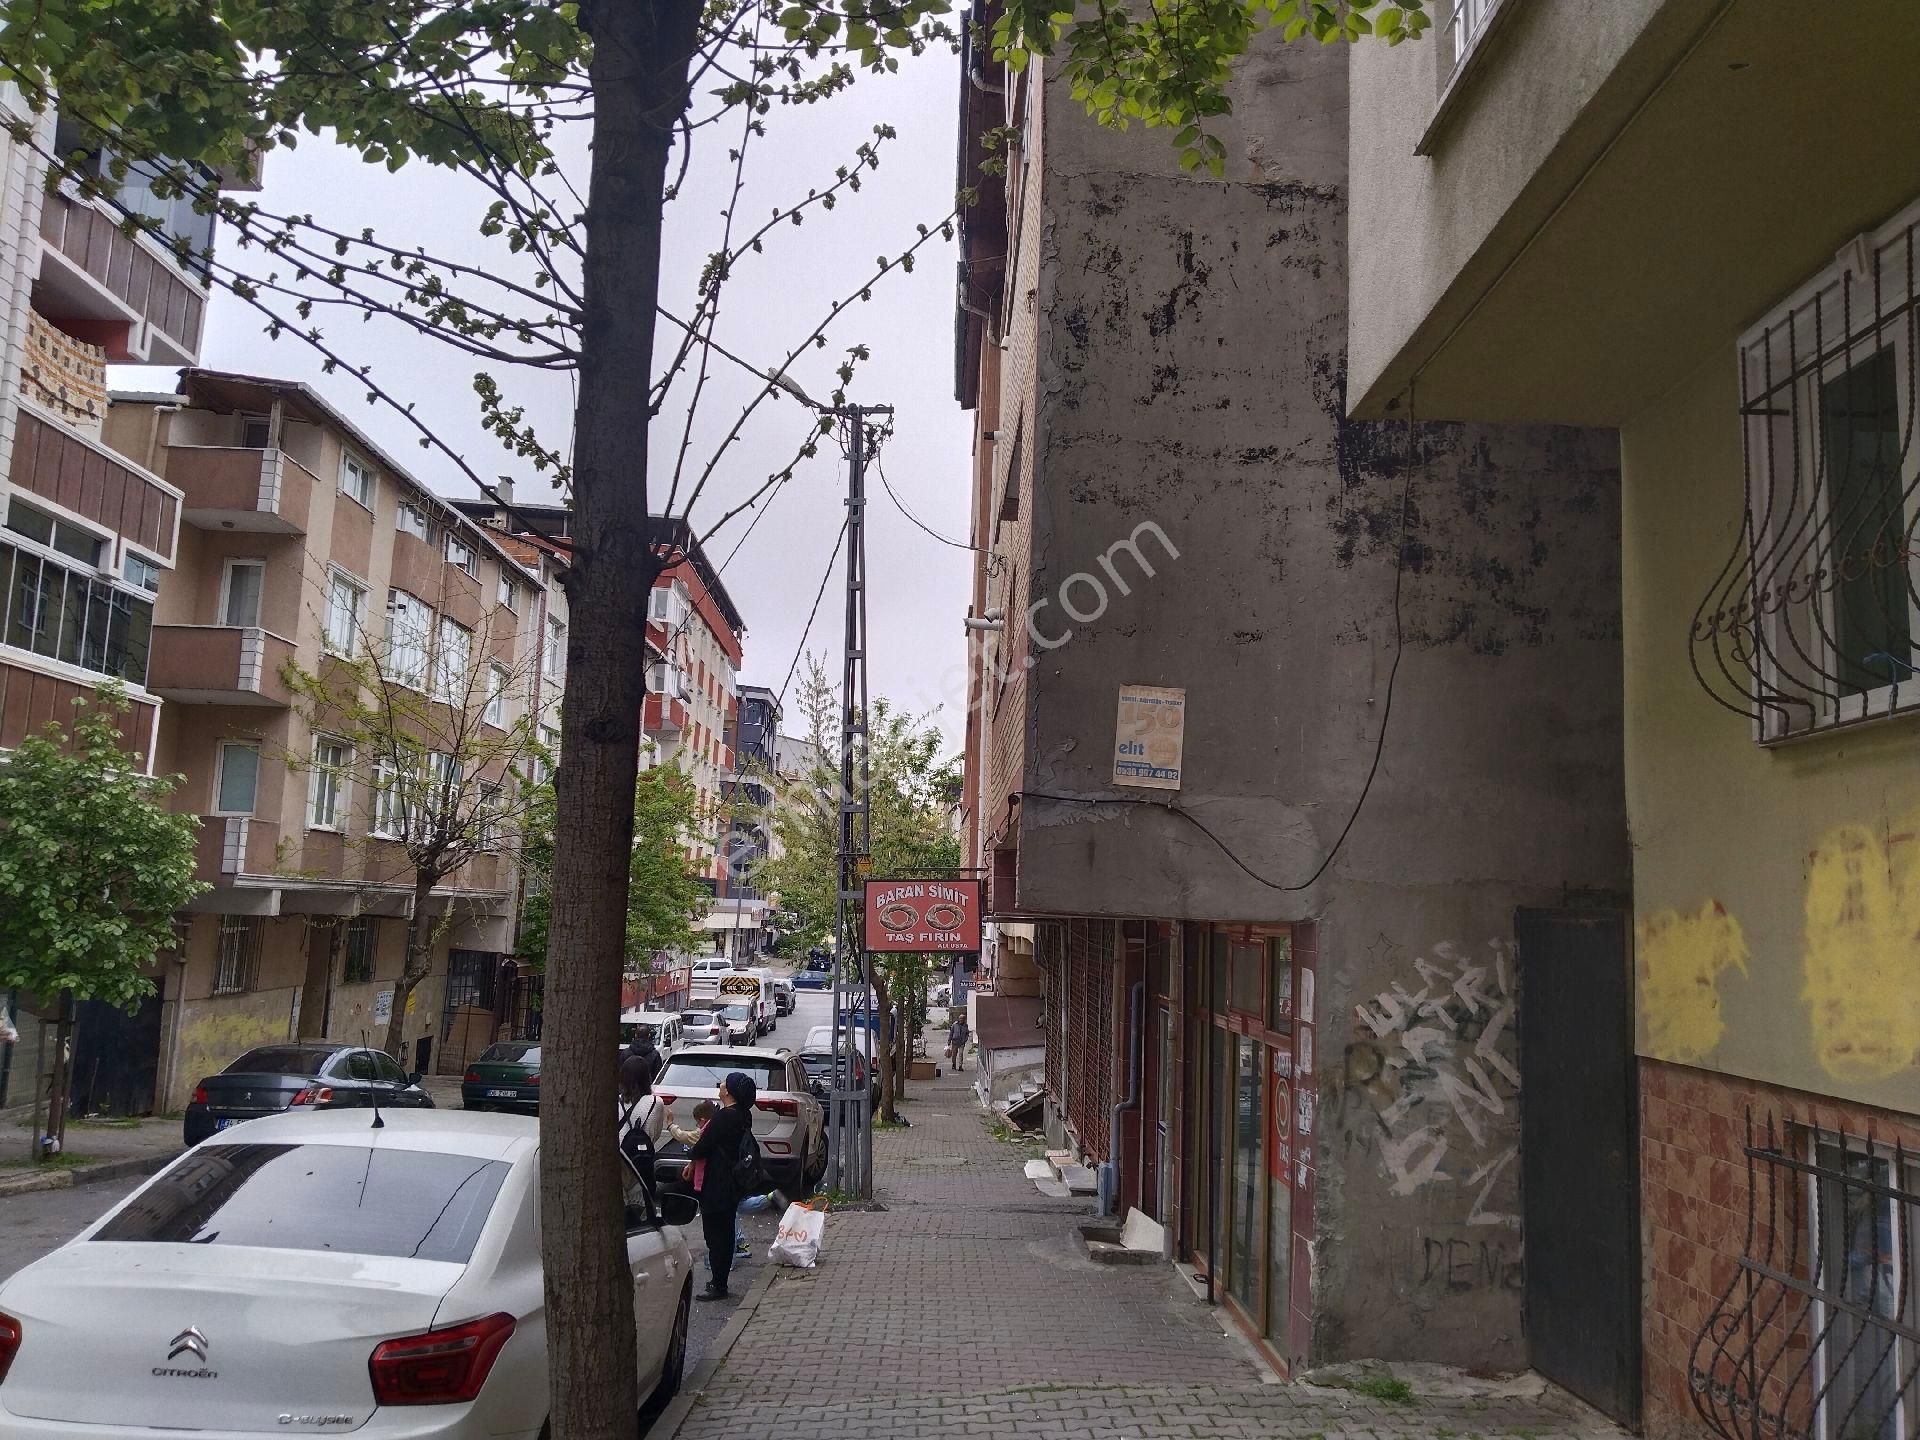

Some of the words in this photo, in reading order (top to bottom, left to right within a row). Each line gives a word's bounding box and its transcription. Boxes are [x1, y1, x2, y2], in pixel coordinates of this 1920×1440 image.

[876, 884, 924, 909] BARAN
[928, 882, 969, 907] SİMİT
[885, 932, 915, 943] TAŞ
[919, 932, 961, 942] FIRIN
